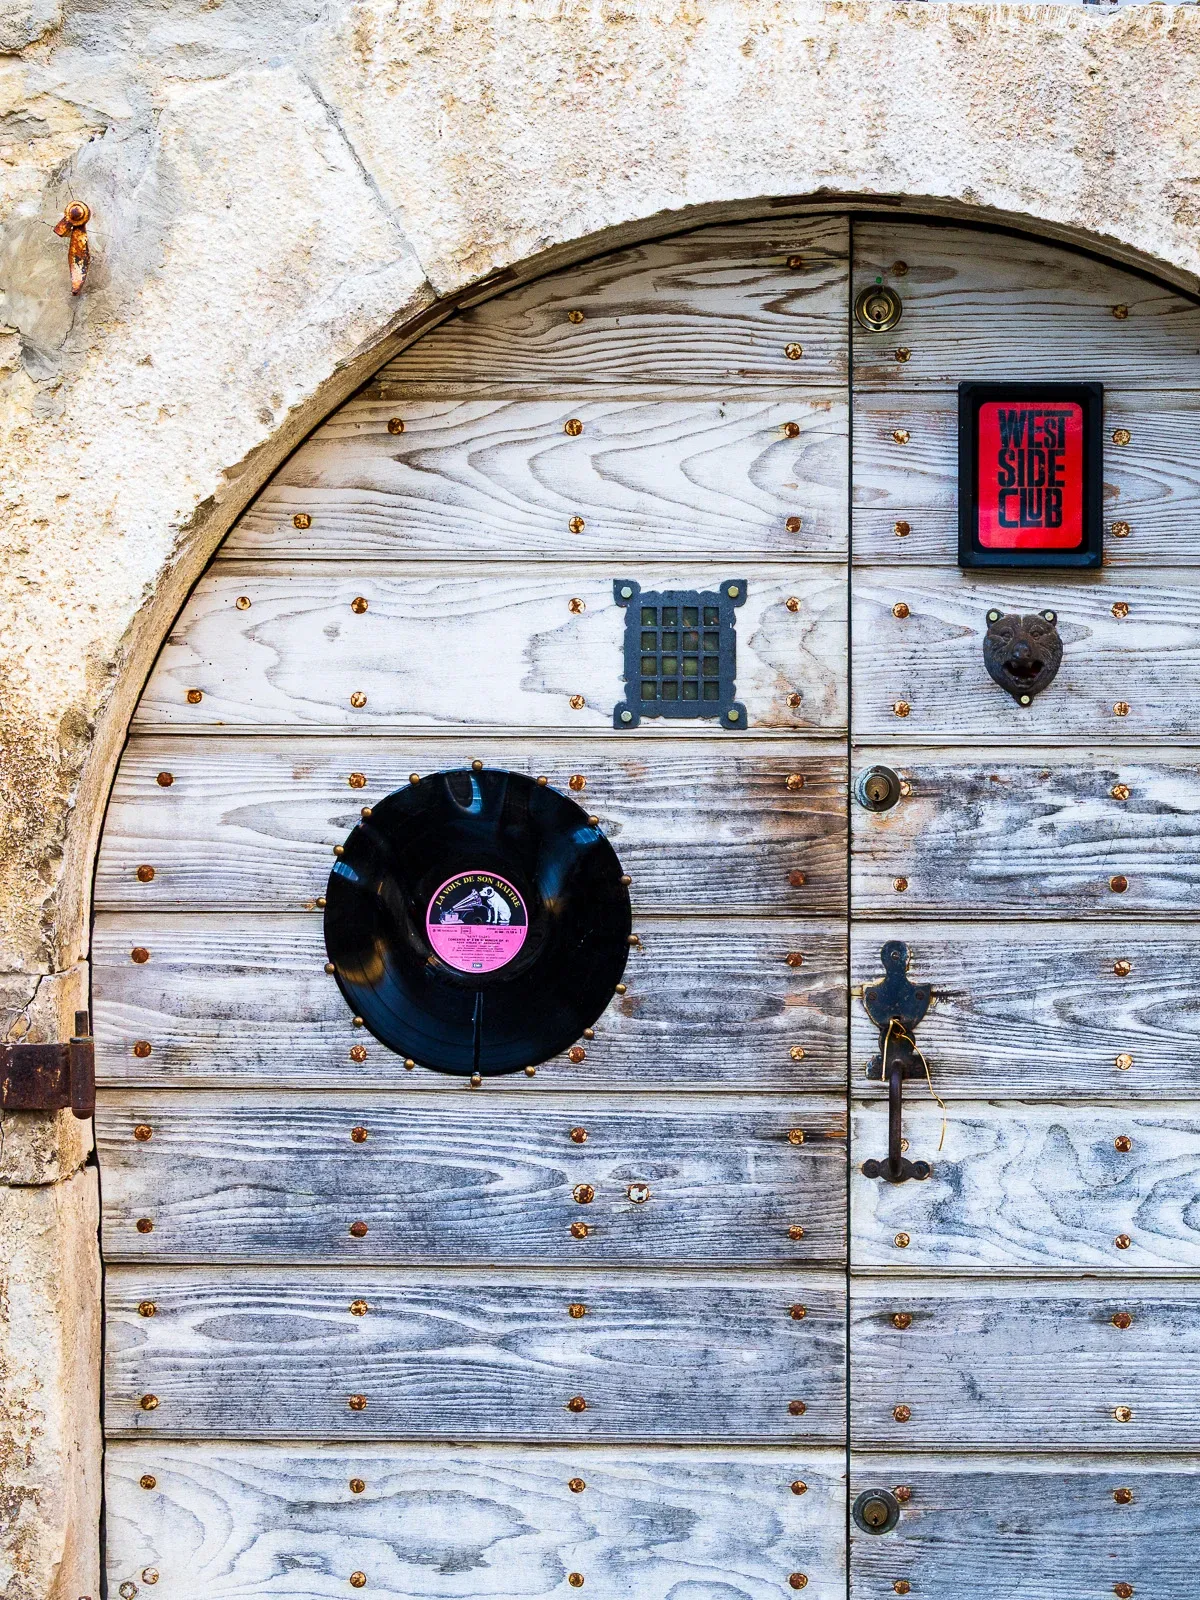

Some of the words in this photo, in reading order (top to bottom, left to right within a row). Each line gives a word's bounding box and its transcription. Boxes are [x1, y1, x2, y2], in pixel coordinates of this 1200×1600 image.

[997, 409, 1073, 448] WEST
[998, 448, 1065, 487] SIDE
[998, 487, 1063, 528] CLUB
[435, 894, 445, 906] LA
[443, 879, 462, 895] VOIX
[463, 875, 475, 884] DE
[477, 875, 494, 884] SON
[495, 880, 521, 908] MAITRE
